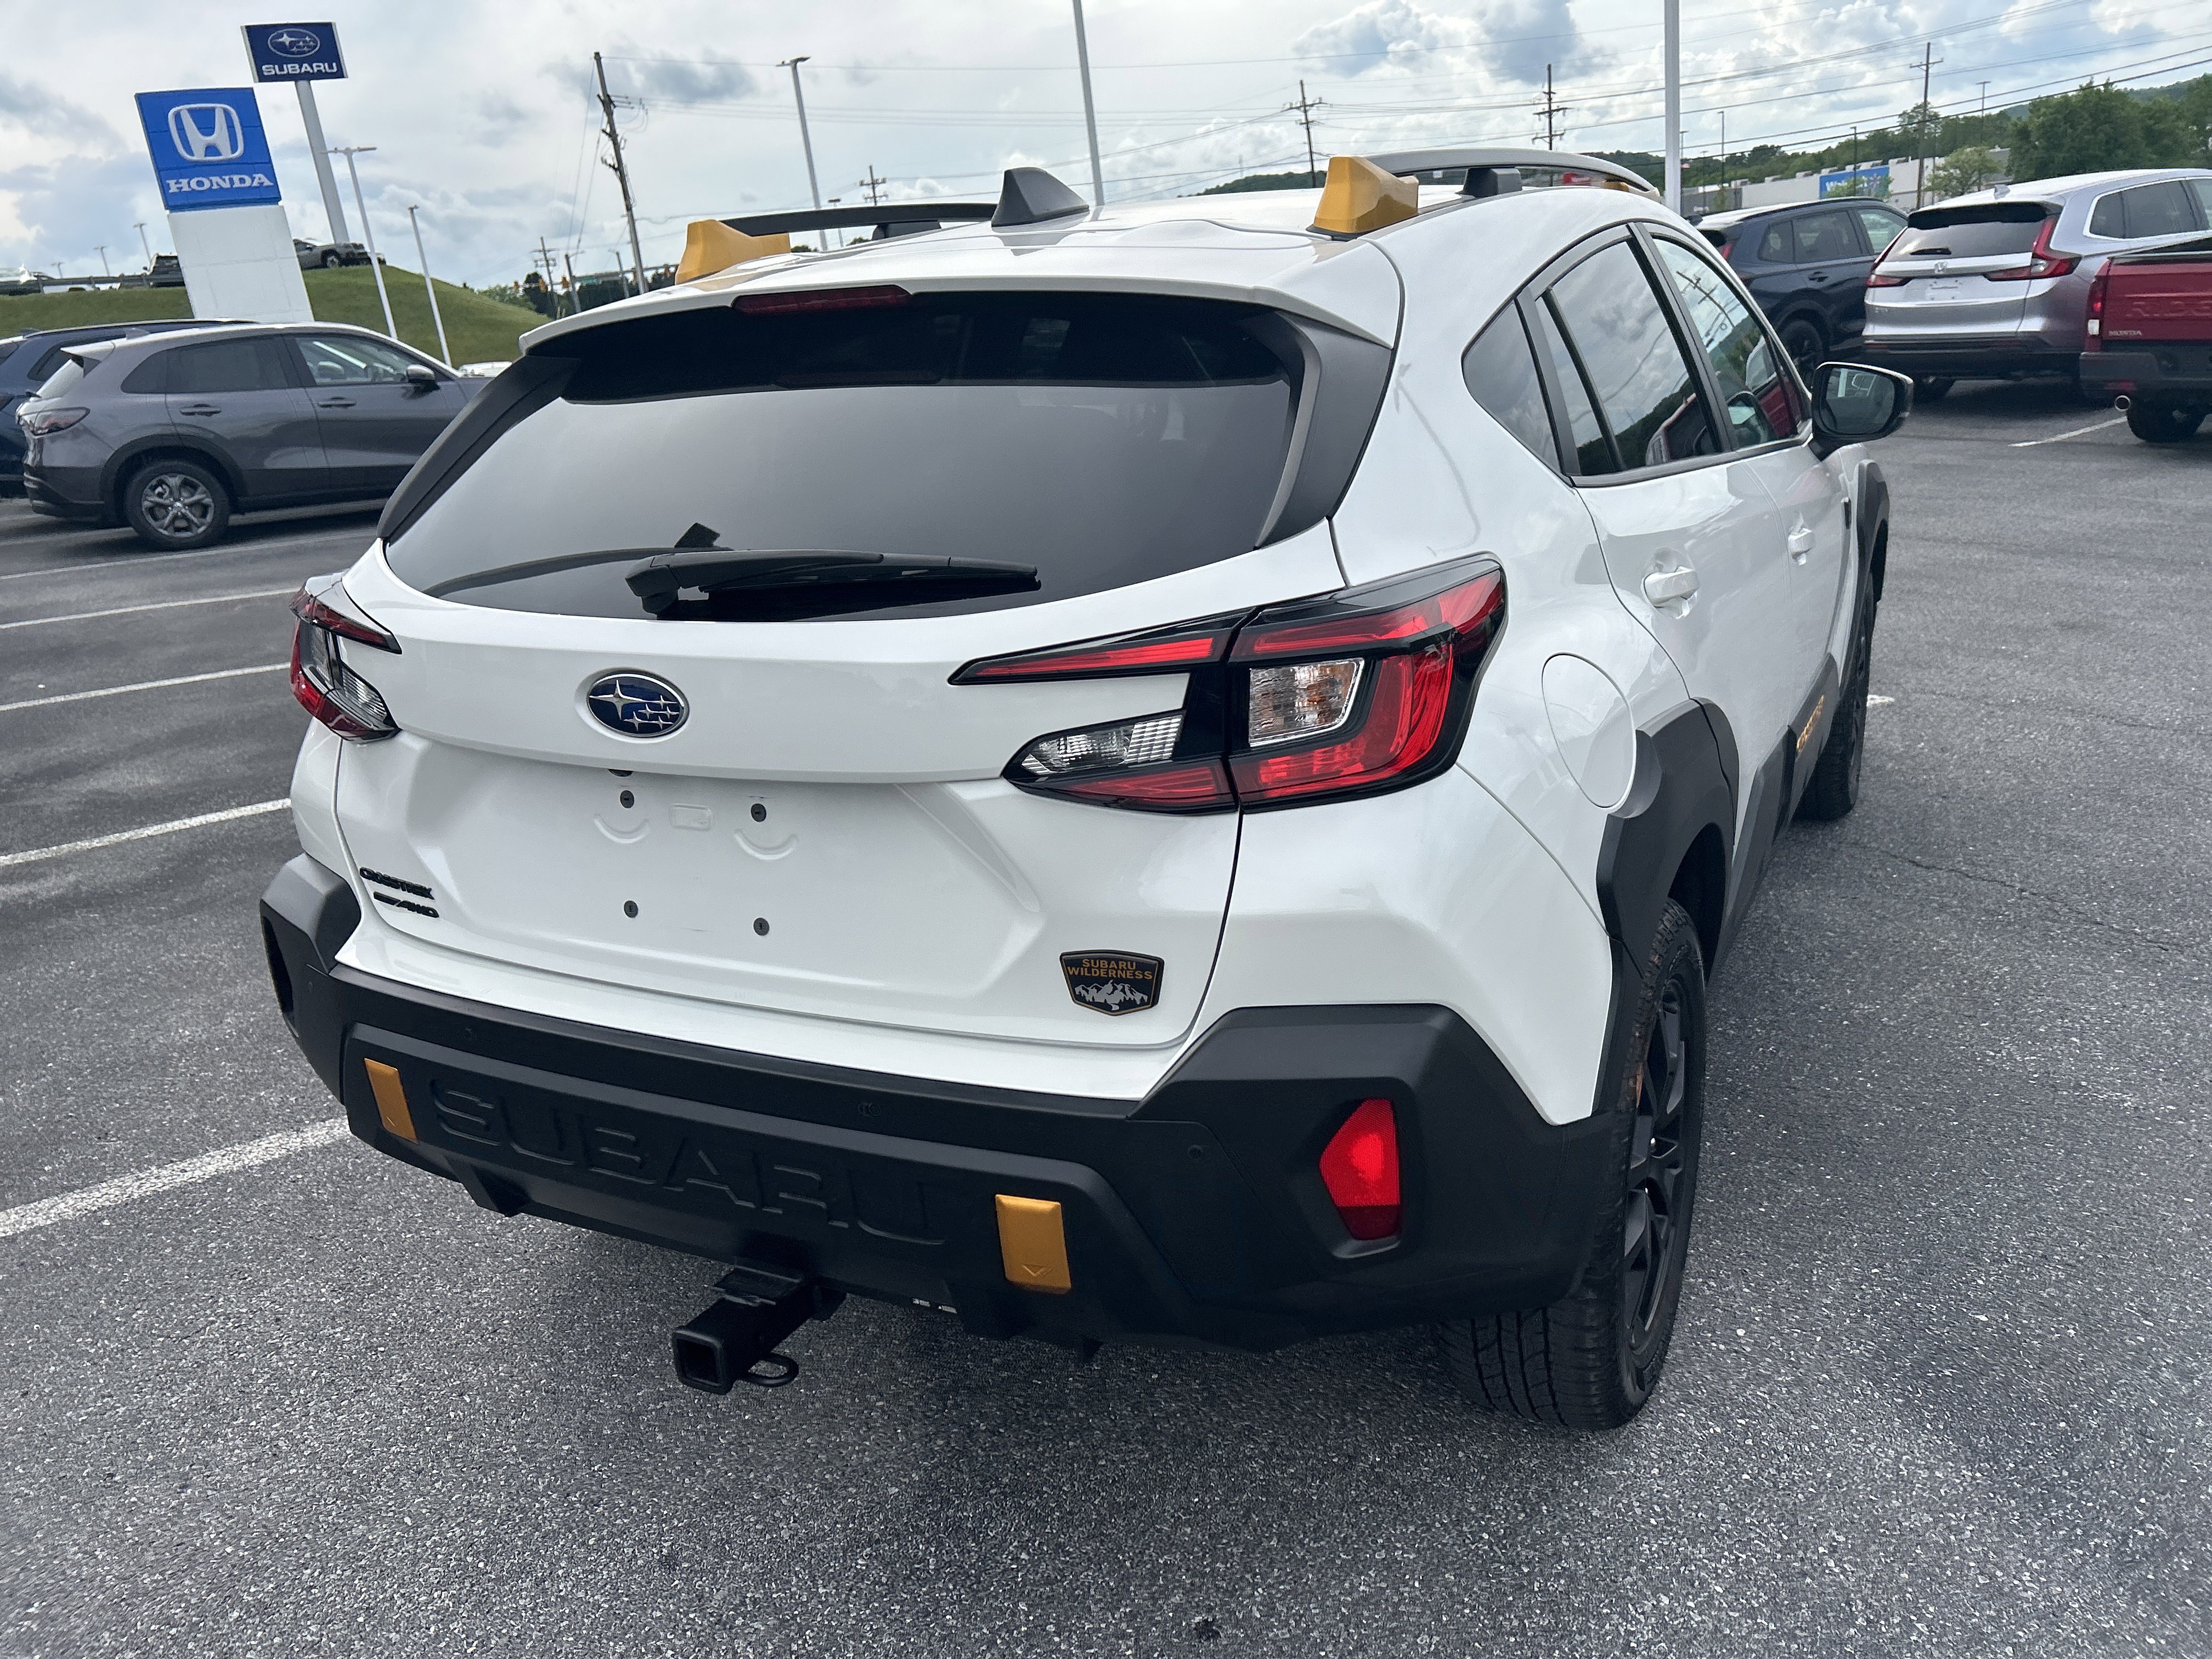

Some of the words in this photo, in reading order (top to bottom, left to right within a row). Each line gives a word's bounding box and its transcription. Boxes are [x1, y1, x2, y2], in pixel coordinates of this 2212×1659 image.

[262, 62, 337, 76] SUBARU
[166, 173, 274, 193] HONDA
[1082, 958, 1136, 970] SUBARU
[1067, 967, 1153, 979] WILDERNESS
[429, 1079, 948, 1246] SUBARU
